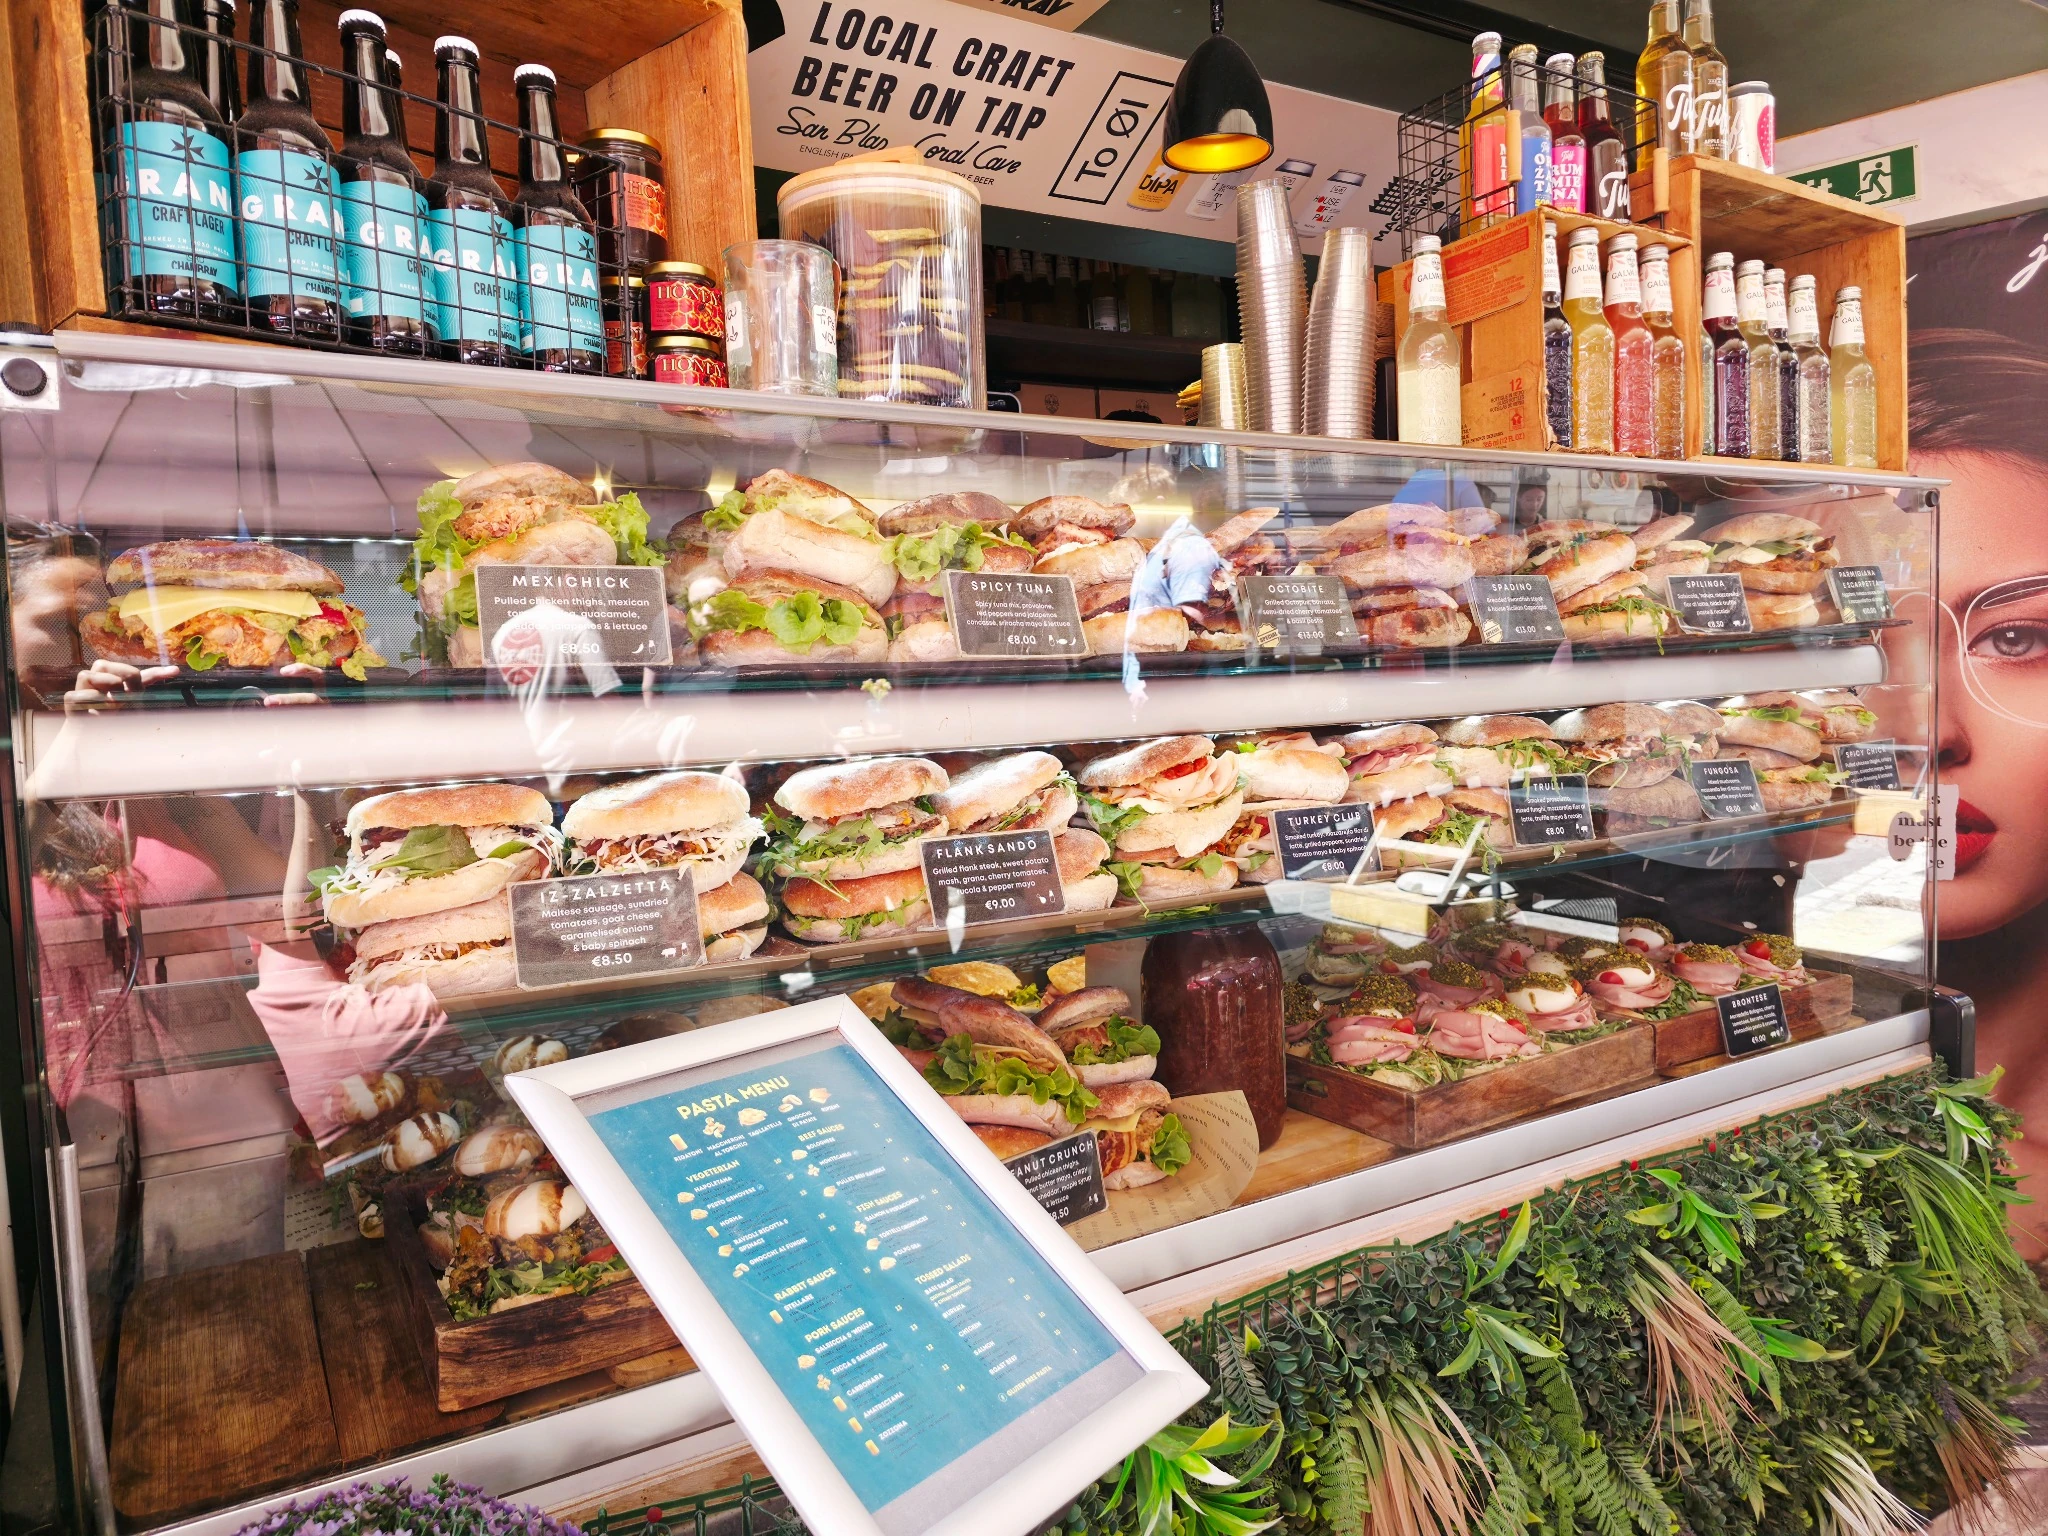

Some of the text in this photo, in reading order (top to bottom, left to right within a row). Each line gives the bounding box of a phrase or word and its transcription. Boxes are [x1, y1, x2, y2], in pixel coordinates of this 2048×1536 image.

[810, 1, 1075, 96] LOCAL CRAFT
[791, 55, 1047, 141] BEER ON TAP
[777, 106, 828, 140] San
[800, 144, 839, 158] ENGLISH
[915, 133, 1021, 174] Coral Cave
[974, 175, 994, 186] BEER
[1139, 174, 1178, 194] DIPA
[153, 205, 224, 235] CRAFT LAGER
[657, 285, 722, 306] HONEY
[1510, 378, 1522, 391] 12
[512, 576, 629, 588] MEXICHICK
[972, 581, 1053, 593] SPICY TUNA
[1268, 585, 1324, 593] OCTOBITE
[1492, 583, 1531, 591] SPADINO
[1686, 580, 1725, 588] SPILINGA
[494, 597, 526, 605] Pulled
[529, 597, 569, 605] chicken
[572, 597, 605, 608] thighs,
[975, 601, 992, 609] Spicy
[1009, 601, 1021, 609] mix,
[581, 611, 640, 620] guacamole,
[613, 622, 647, 631] lettuce
[1008, 635, 1036, 644] €8.00
[559, 643, 600, 654] €8.50
[1846, 750, 1864, 758] SPICY
[1704, 767, 1739, 775] FUNGOSA
[1533, 782, 1564, 791] TRULI
[1288, 812, 1361, 826] TURKEY CLUB
[1285, 831, 1325, 841] Smoked turkey,
[1546, 827, 1565, 835] €8.00
[1345, 836, 1367, 844] sundried
[937, 840, 1036, 859] FLANK SANDO
[1333, 847, 1346, 855] baby
[933, 866, 958, 875] Grilled
[959, 864, 978, 872] flank
[1003, 859, 1024, 868] sweet
[1025, 857, 1049, 866] potato
[1322, 861, 1344, 871] €8.00
[939, 868, 1048, 886] mash, grana, cherry tomatoes,
[541, 880, 670, 904] IZ-ZALZETTA
[989, 883, 1014, 892] pepper
[1016, 880, 1036, 888] mayo
[542, 897, 668, 918] Maltese sausage, sundried
[985, 898, 1015, 910] €9.00
[551, 911, 663, 930] tomatoes, goat cheese,
[560, 924, 654, 941] caramelised onions
[573, 936, 646, 952] & baby spinach
[592, 952, 632, 967] €8.50
[1732, 993, 1767, 1008] BRONTESE
[676, 1074, 789, 1119] PASTA MENU
[673, 1133, 745, 1162] RIGATONI MACCHERONI
[1010, 1140, 1094, 1178] EANUT CRUNCH
[685, 1159, 740, 1182] VEGETERIAN
[1025, 1174, 1041, 1185] Pulled
[1042, 1167, 1062, 1178] chicken
[1051, 1207, 1069, 1220] 8.50
[773, 1266, 836, 1301] RABBIT SAUCE
[804, 1307, 865, 1342] PORK SAUCES
